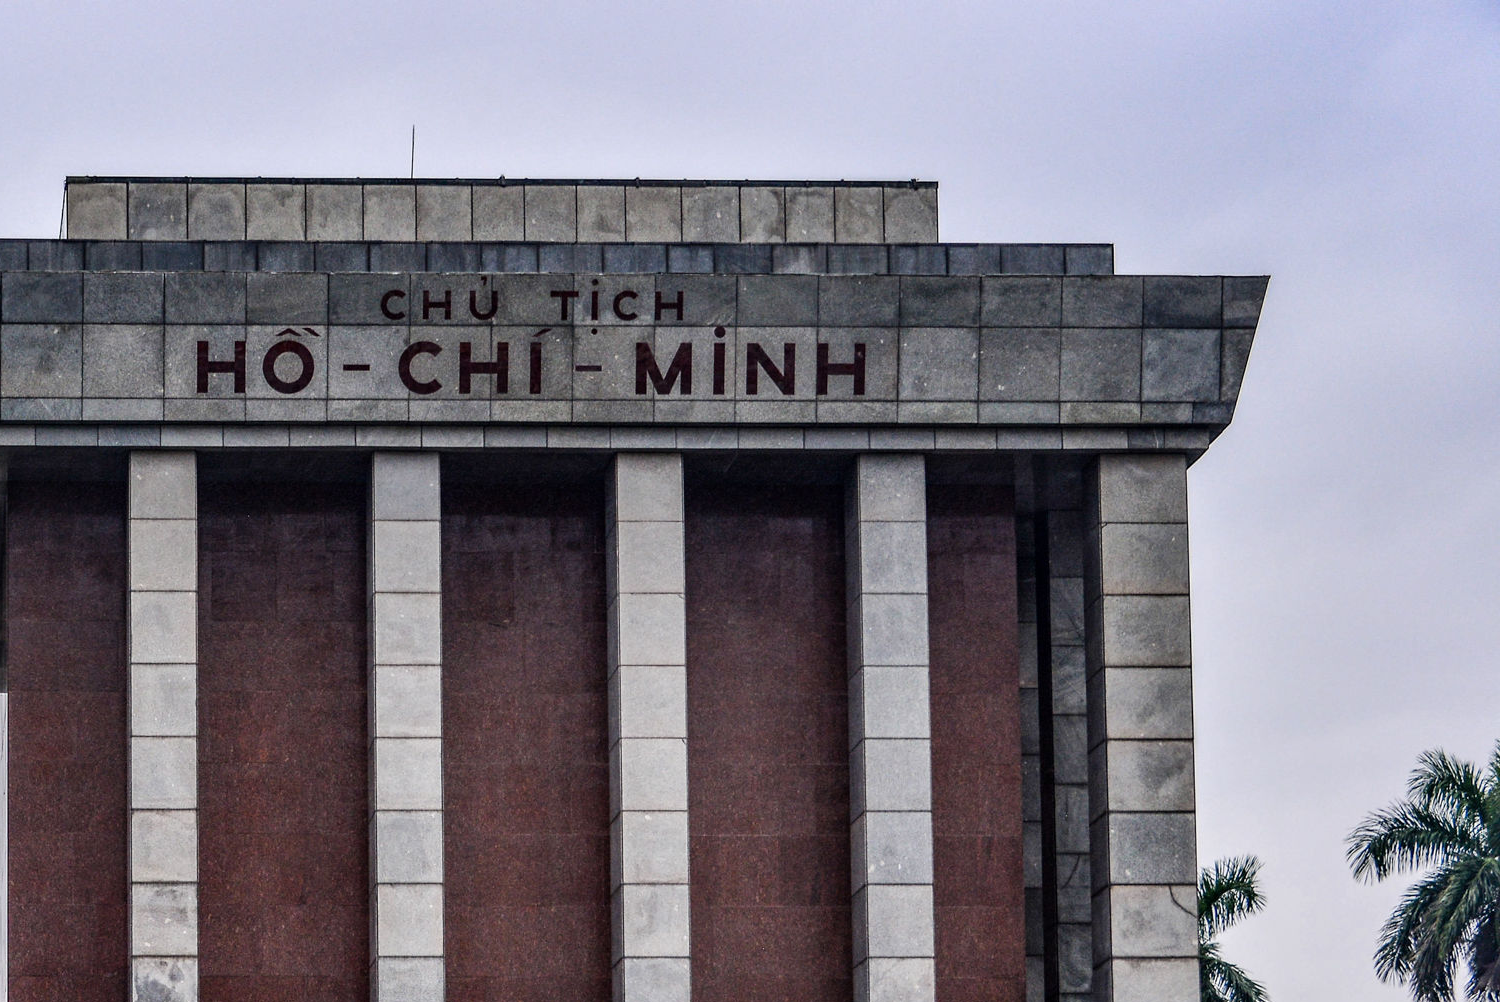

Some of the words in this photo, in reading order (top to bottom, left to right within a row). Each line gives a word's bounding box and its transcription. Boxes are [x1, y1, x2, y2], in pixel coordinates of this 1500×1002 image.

[380, 277, 498, 320] CHỦ
[550, 279, 684, 335] TỊCH
[197, 328, 321, 394] HỒ
[398, 328, 552, 395] CHÍ
